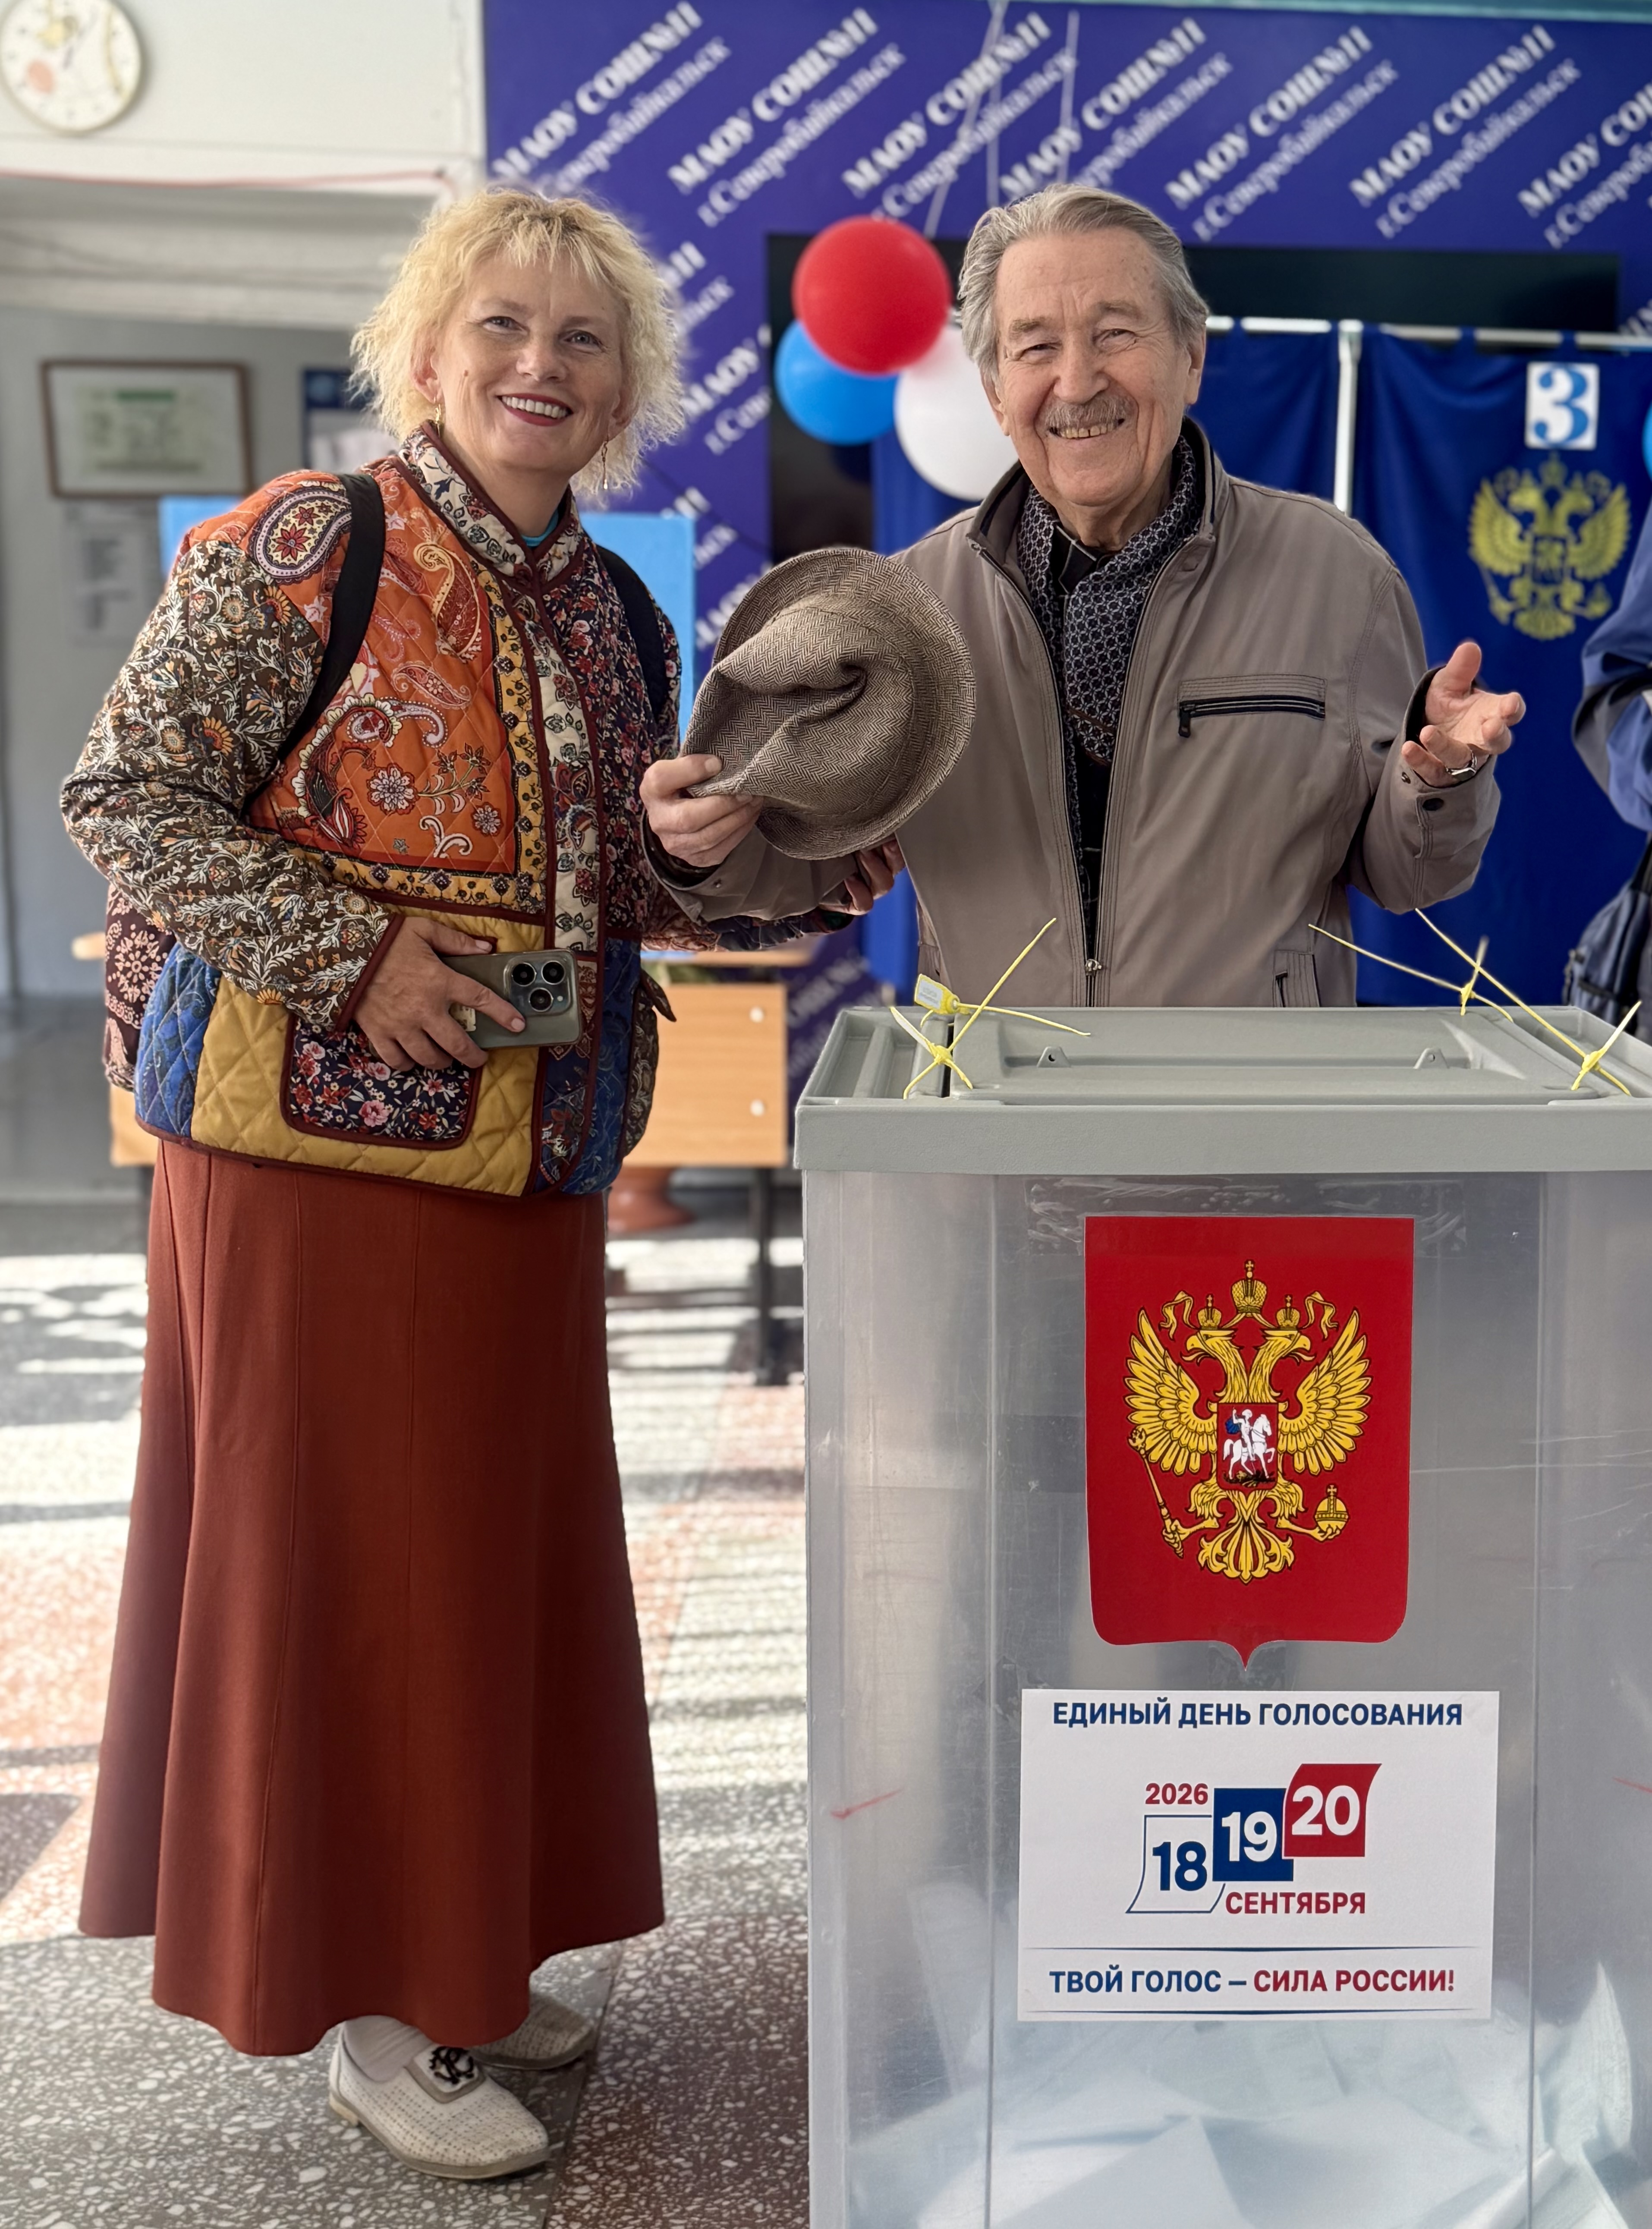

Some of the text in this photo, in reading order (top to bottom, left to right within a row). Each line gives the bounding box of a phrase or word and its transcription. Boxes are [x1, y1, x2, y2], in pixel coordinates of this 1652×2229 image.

[668, 107, 754, 194] МАОУ
[842, 111, 927, 199] МАОУ
[1164, 123, 1249, 211] МАОУ
[1349, 120, 1433, 208] МАОУ
[1517, 132, 1600, 218] МАОУ
[1534, 363, 1589, 448] 3
[1053, 1696, 1463, 1729] ЕДИНЫЙ ДЕНЬ ГОЛОСОВАНИЯ
[1145, 1782, 1208, 1805] 2026
[1152, 1785, 1360, 1892] 18 19 20
[1225, 1891, 1366, 1915] СЕНТЯБРЯ
[1048, 1964, 1123, 1993] ТВОЙ
[1131, 1969, 1221, 1993] ГОЛОС
[1253, 1969, 1328, 1993] СИЛА
[1335, 1969, 1454, 1992] РОССИИ!
